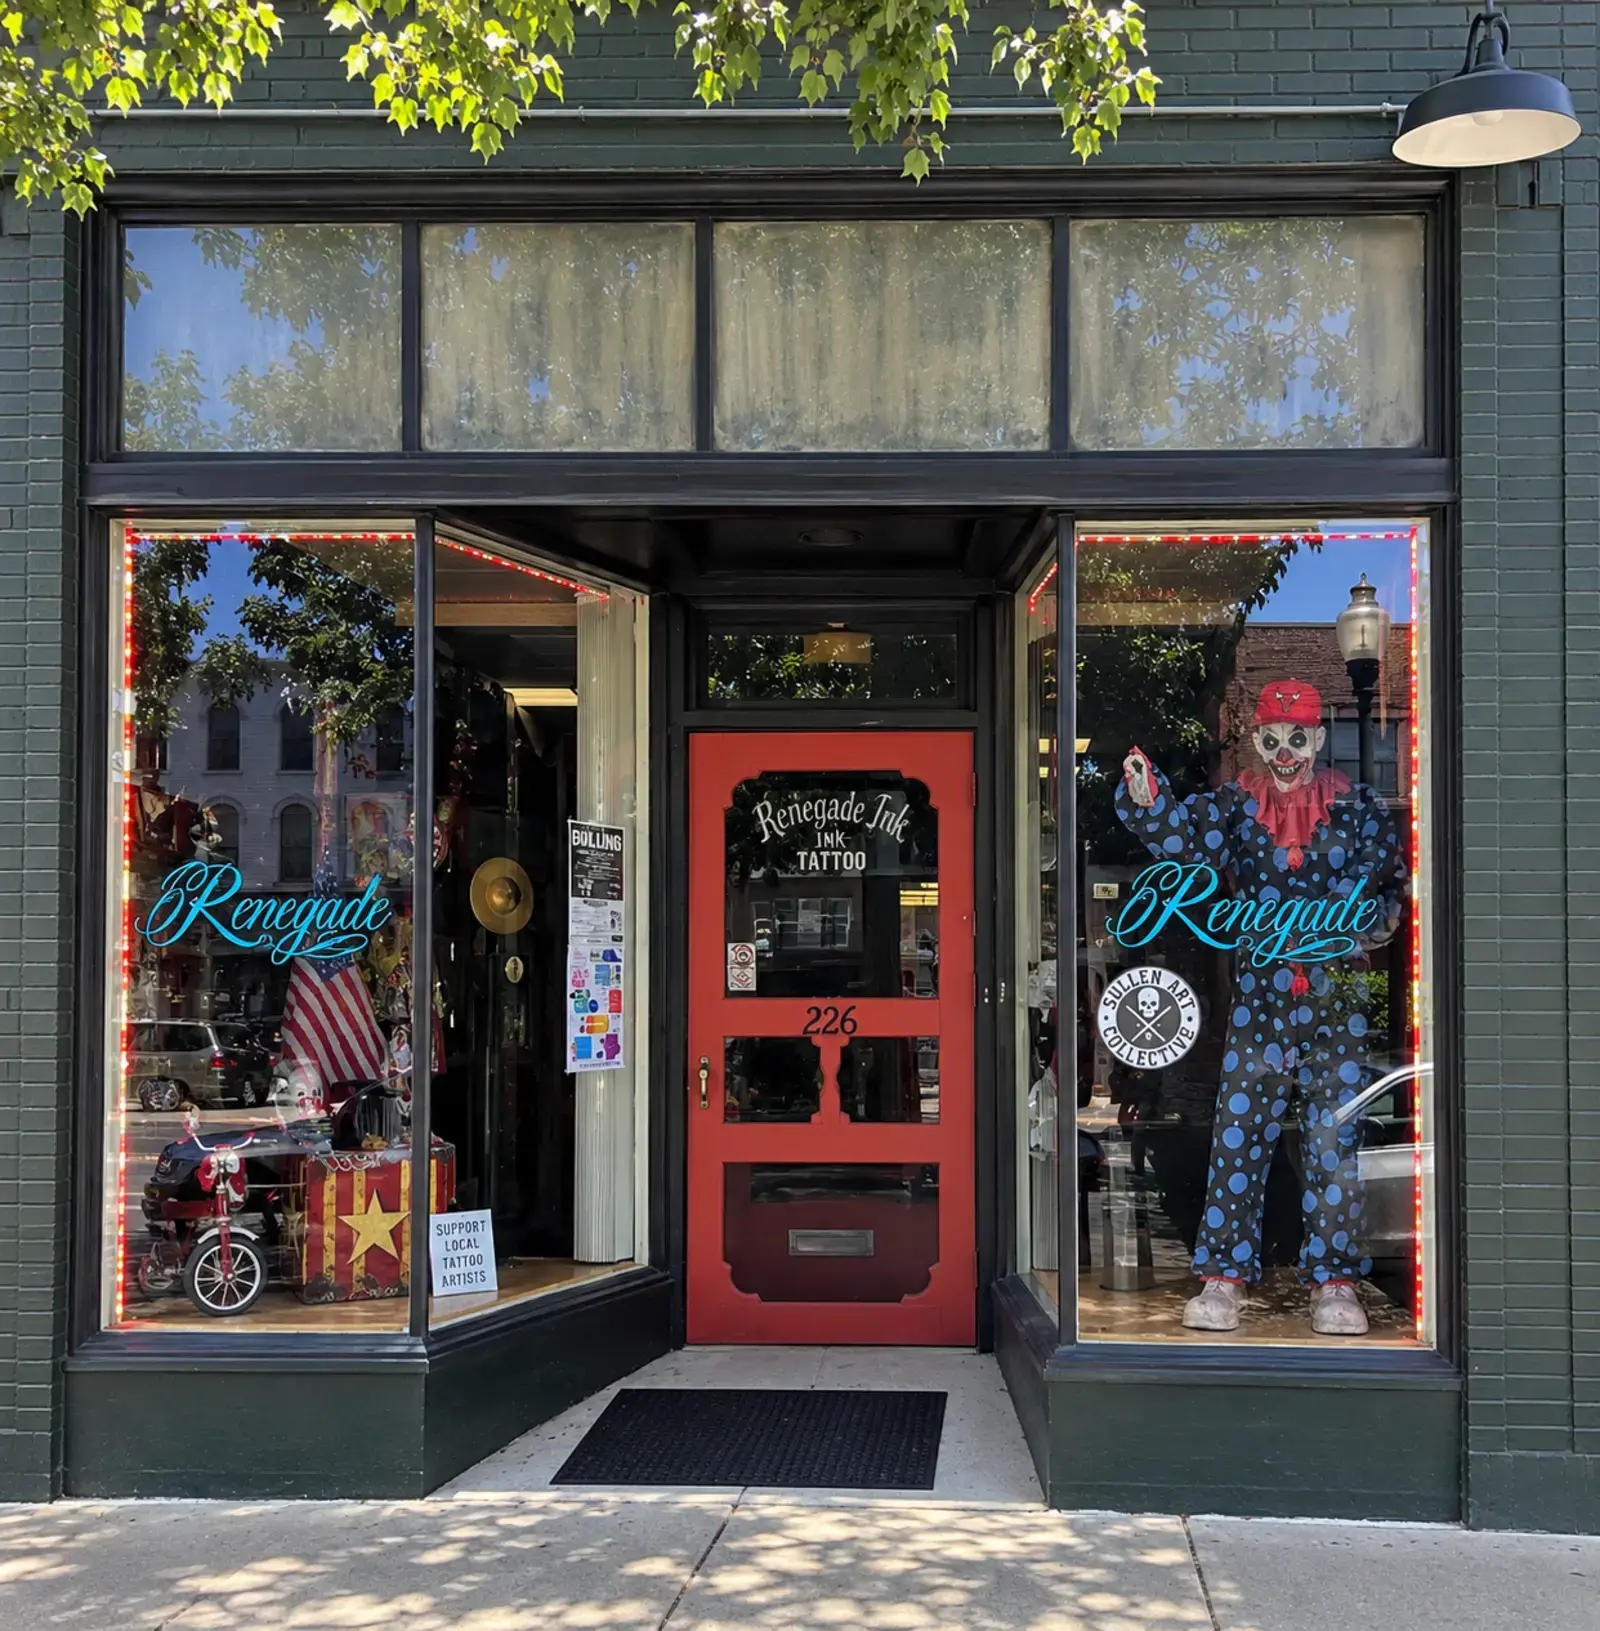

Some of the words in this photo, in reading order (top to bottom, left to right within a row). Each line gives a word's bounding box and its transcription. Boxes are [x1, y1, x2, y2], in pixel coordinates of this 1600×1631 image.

[751, 791, 865, 844] Renegade
[865, 793, 910, 844] Ink
[815, 829, 851, 849] INK
[796, 851, 866, 871] TATTOO
[134, 861, 393, 966] Renegade
[1105, 861, 1378, 968] Renegade
[1103, 969, 1162, 1010] SULLEN
[1167, 979, 1195, 1010] ART
[802, 1005, 857, 1036] 226
[1103, 1026, 1195, 1066] COLLECTIVE
[436, 1220, 486, 1236] SUPPORT
[445, 1238, 480, 1252] LOCAL
[442, 1254, 484, 1270] TATTOO
[442, 1270, 487, 1288] ARTISTS
